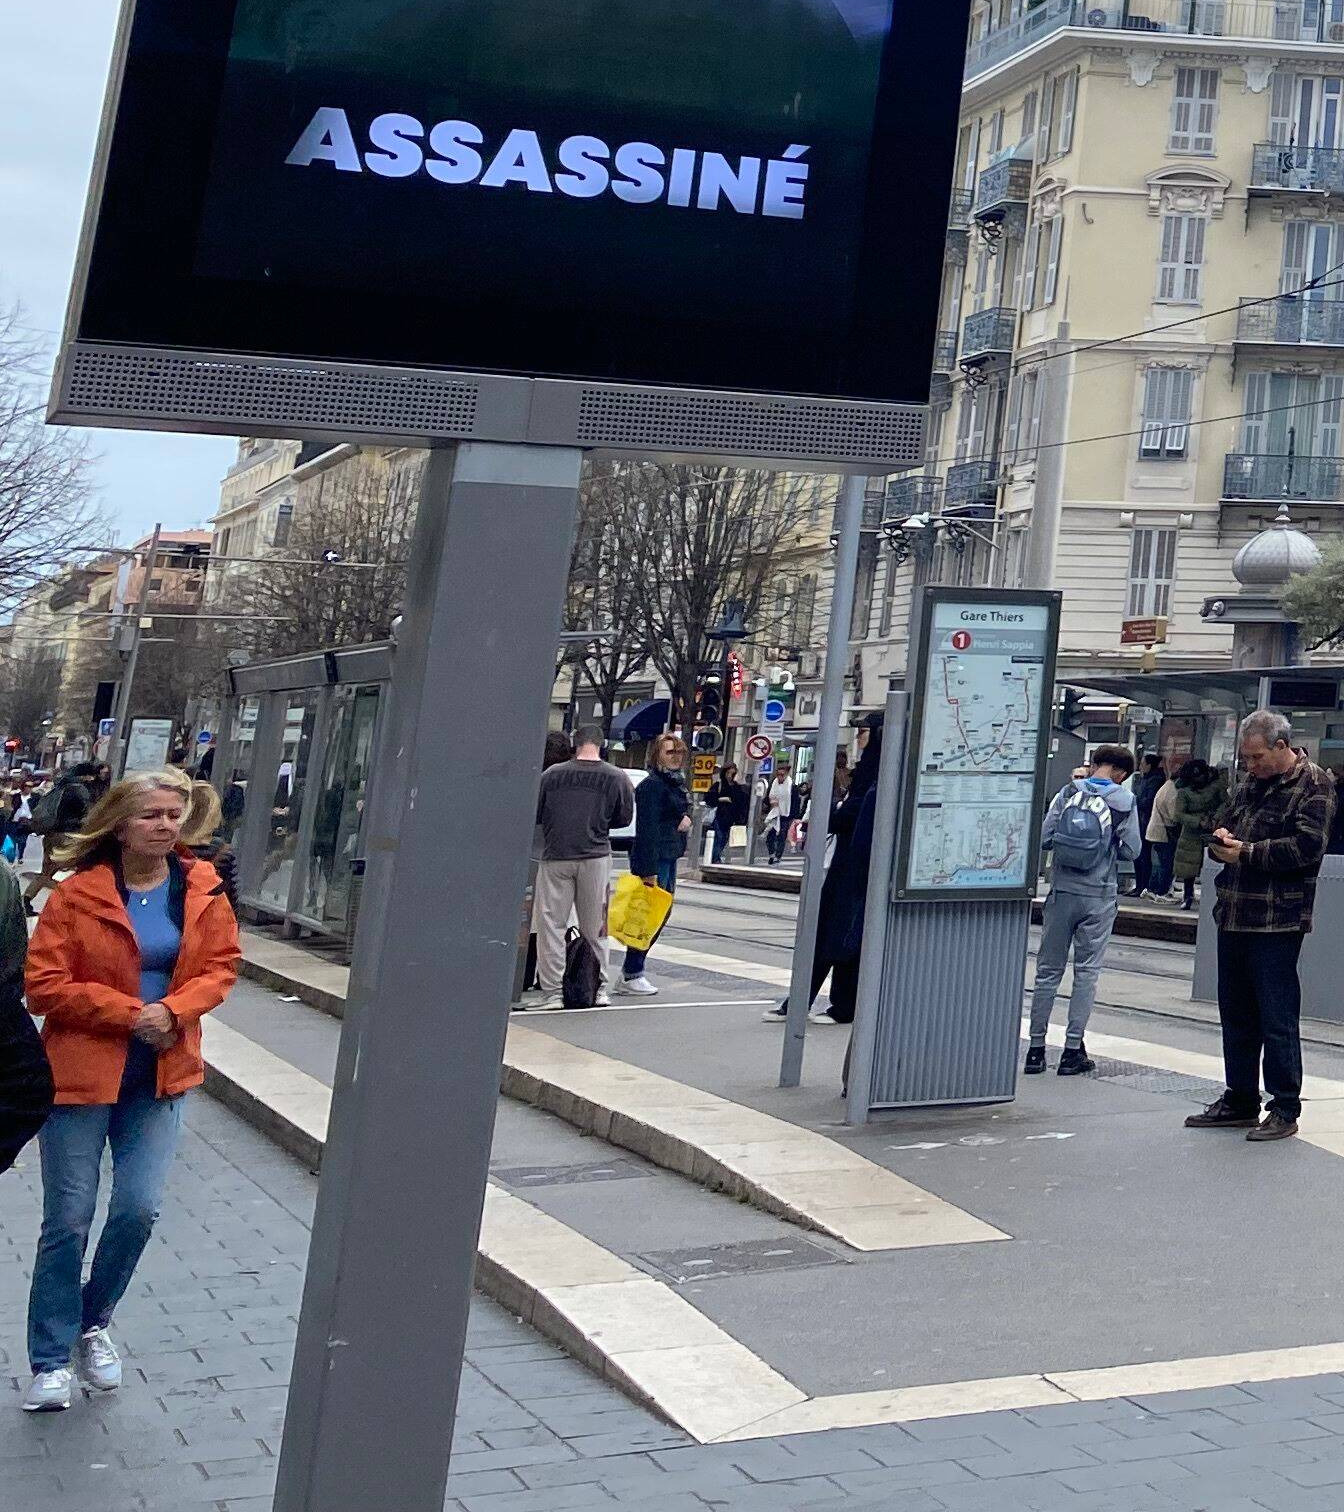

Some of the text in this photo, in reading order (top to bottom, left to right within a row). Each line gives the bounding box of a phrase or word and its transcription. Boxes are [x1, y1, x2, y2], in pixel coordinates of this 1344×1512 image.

[284, 105, 811, 220] ASSASSINÉ
[960, 609, 1024, 623] Gare Thiers
[957, 633, 966, 648] 1
[695, 759, 713, 770] 30
